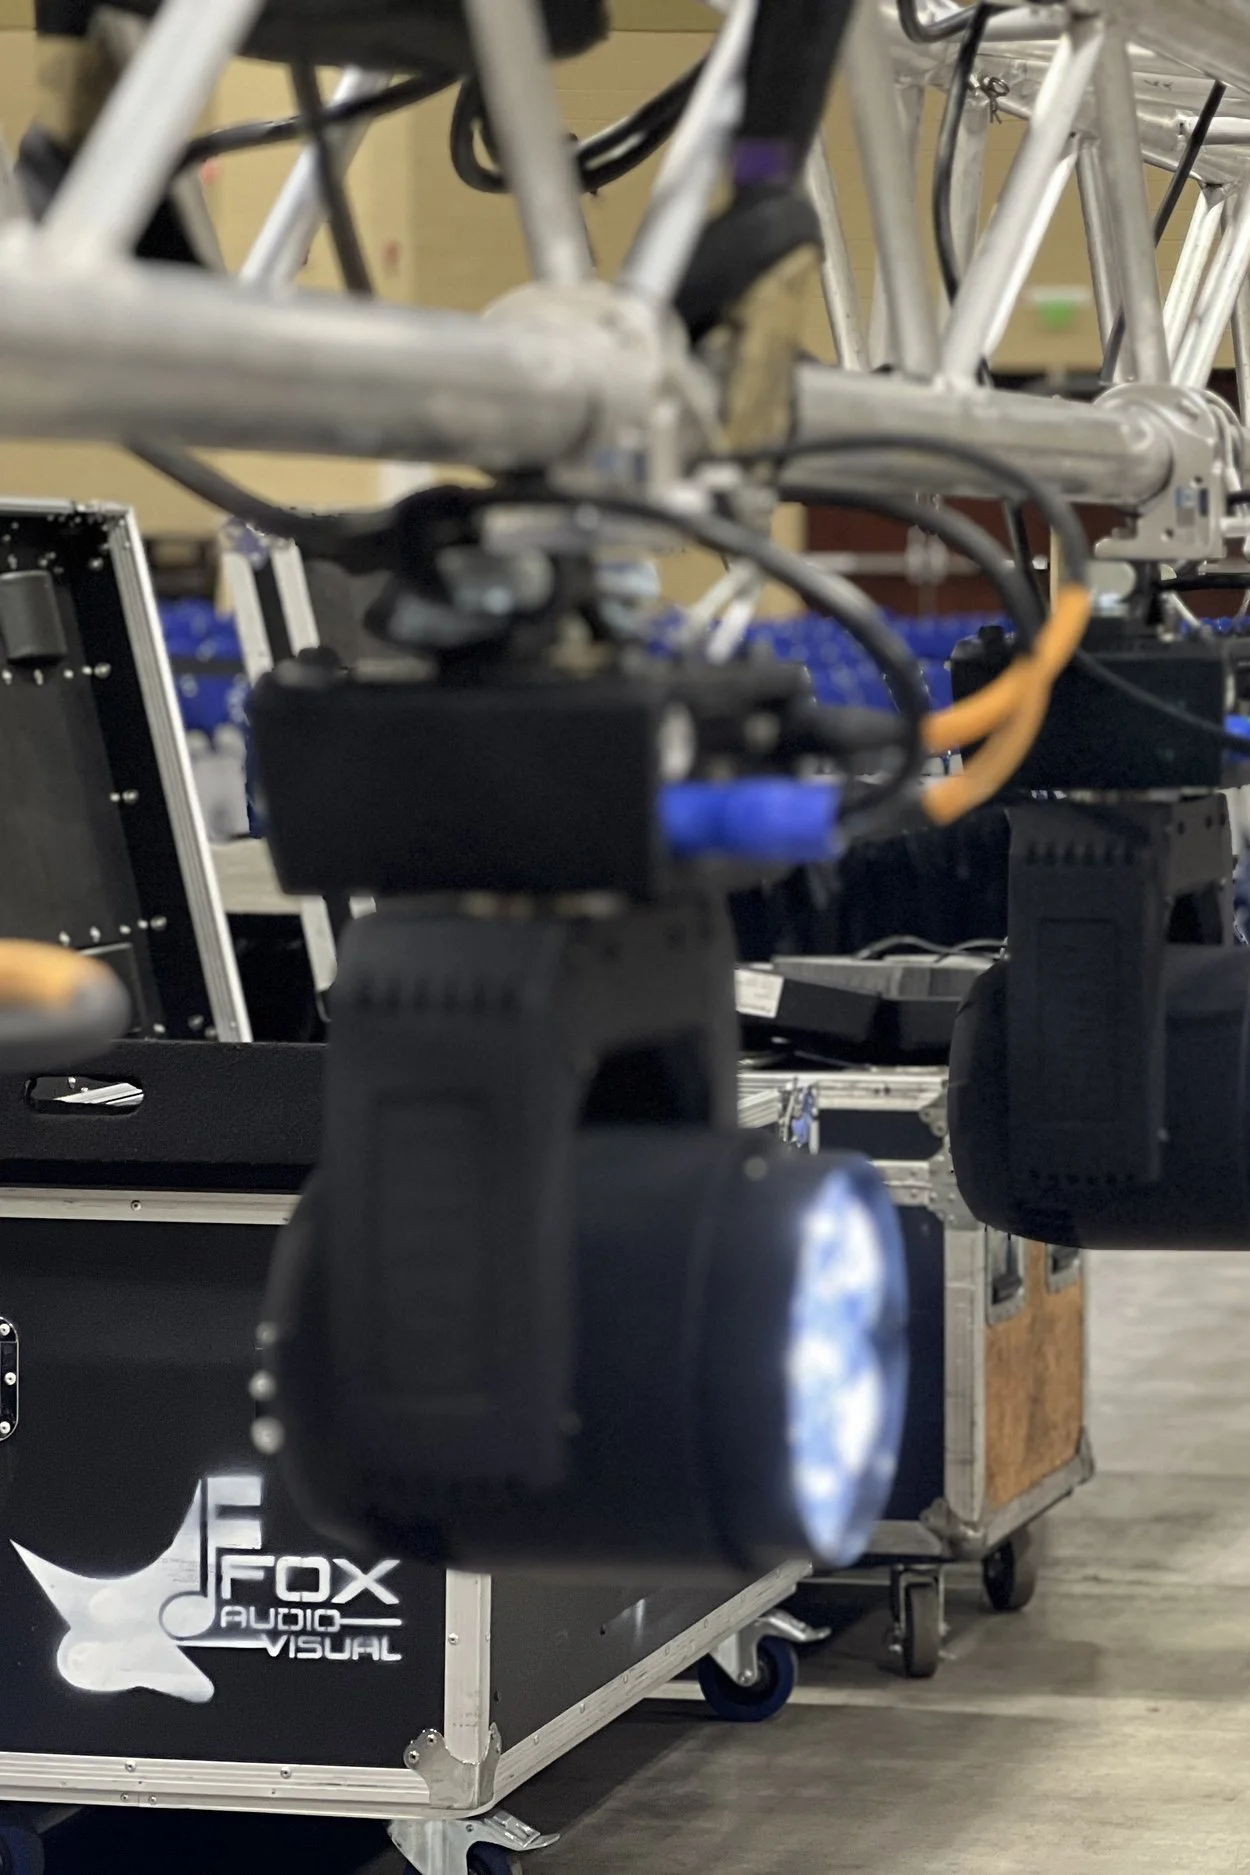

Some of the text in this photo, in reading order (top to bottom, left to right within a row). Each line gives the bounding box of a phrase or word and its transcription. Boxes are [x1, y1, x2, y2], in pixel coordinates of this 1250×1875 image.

[221, 1556, 400, 1604] FOX
[220, 1606, 341, 1632] AUDIO
[262, 1634, 402, 1661] VISUAL
